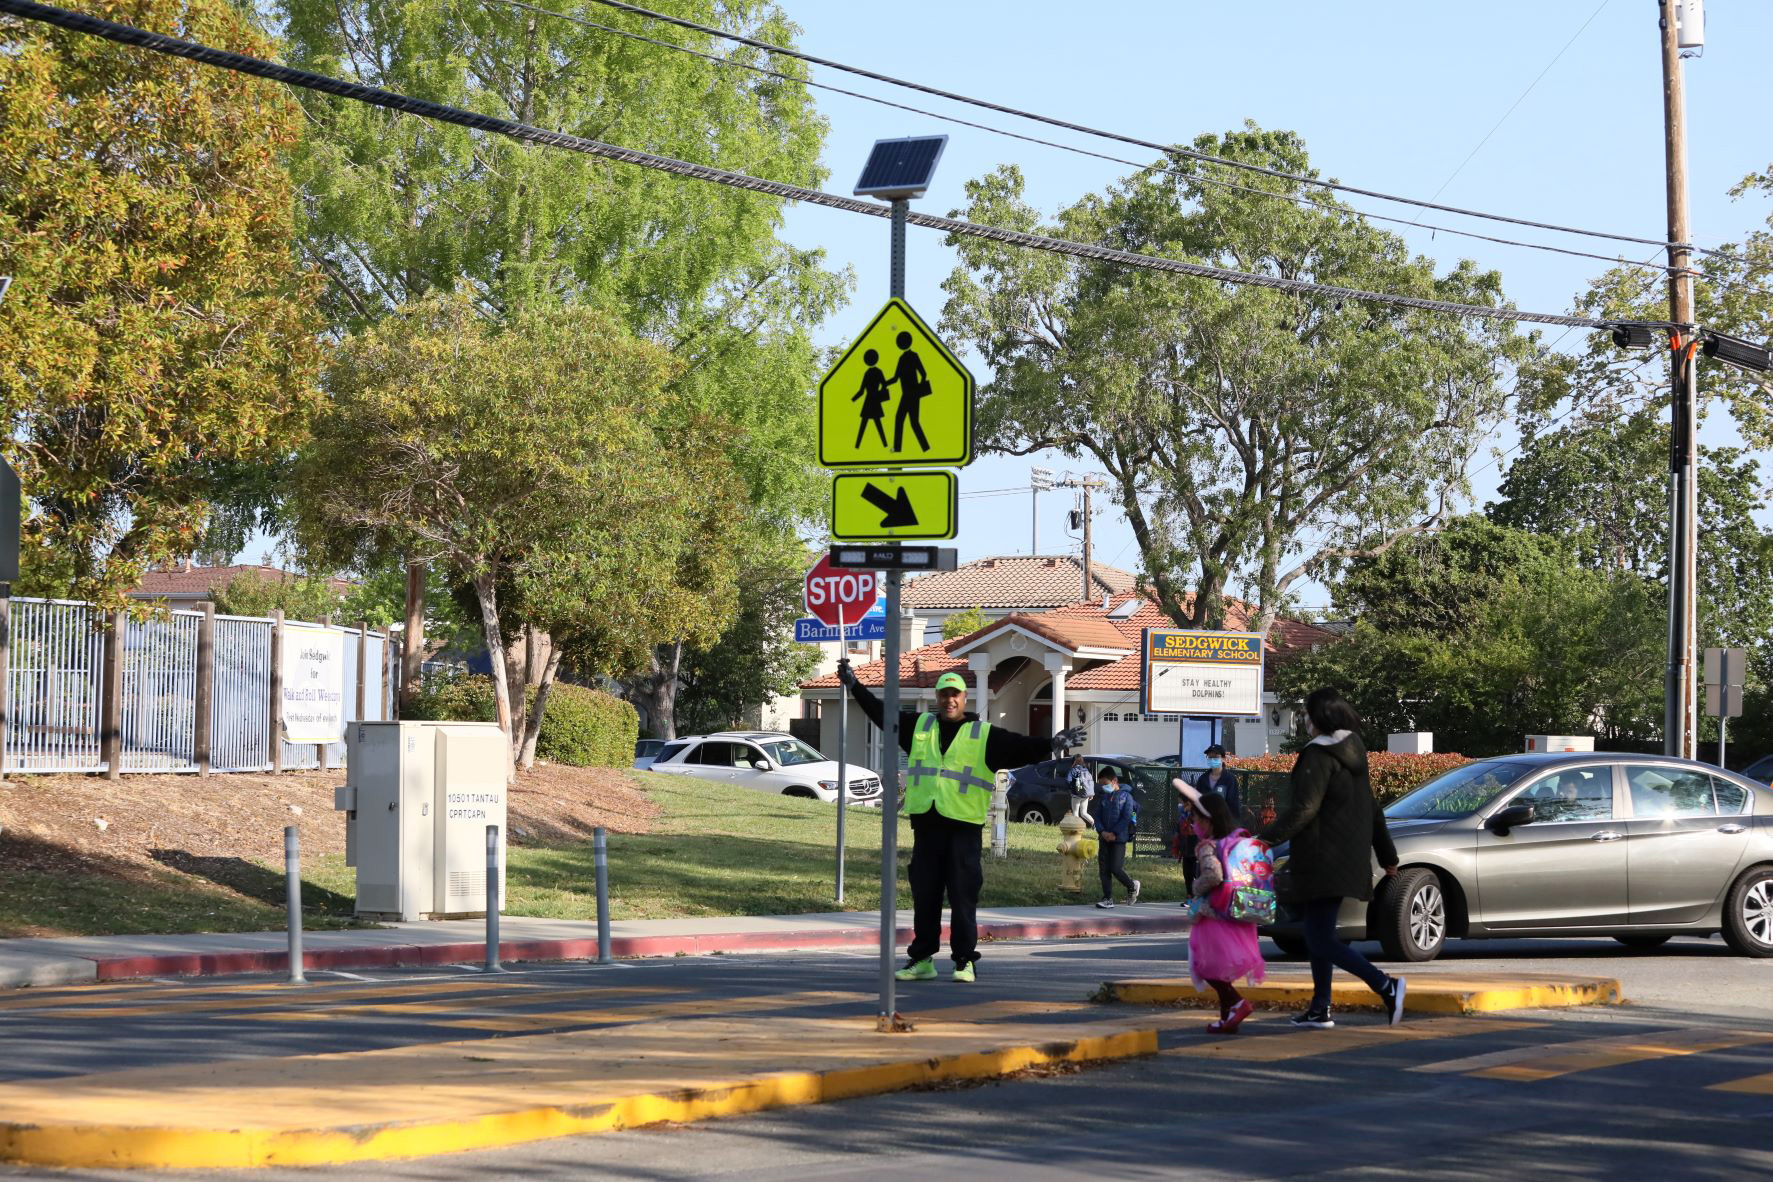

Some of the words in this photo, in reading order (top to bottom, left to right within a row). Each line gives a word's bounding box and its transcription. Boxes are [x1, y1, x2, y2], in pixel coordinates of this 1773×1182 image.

[809, 575, 873, 605] STOP
[869, 623, 885, 633] Ave
[1165, 635, 1249, 651] SEDGWICK
[1153, 647, 1213, 659] ELEMENTARY
[1217, 651, 1260, 660] SCHOOL
[310, 667, 318, 679] for
[1182, 678, 1200, 687] STAY
[1203, 679, 1232, 688] HEALTHY
[1192, 689, 1225, 698] DOLPHINS!
[448, 793, 470, 803] 10501
[471, 793, 499, 804] TANTAU
